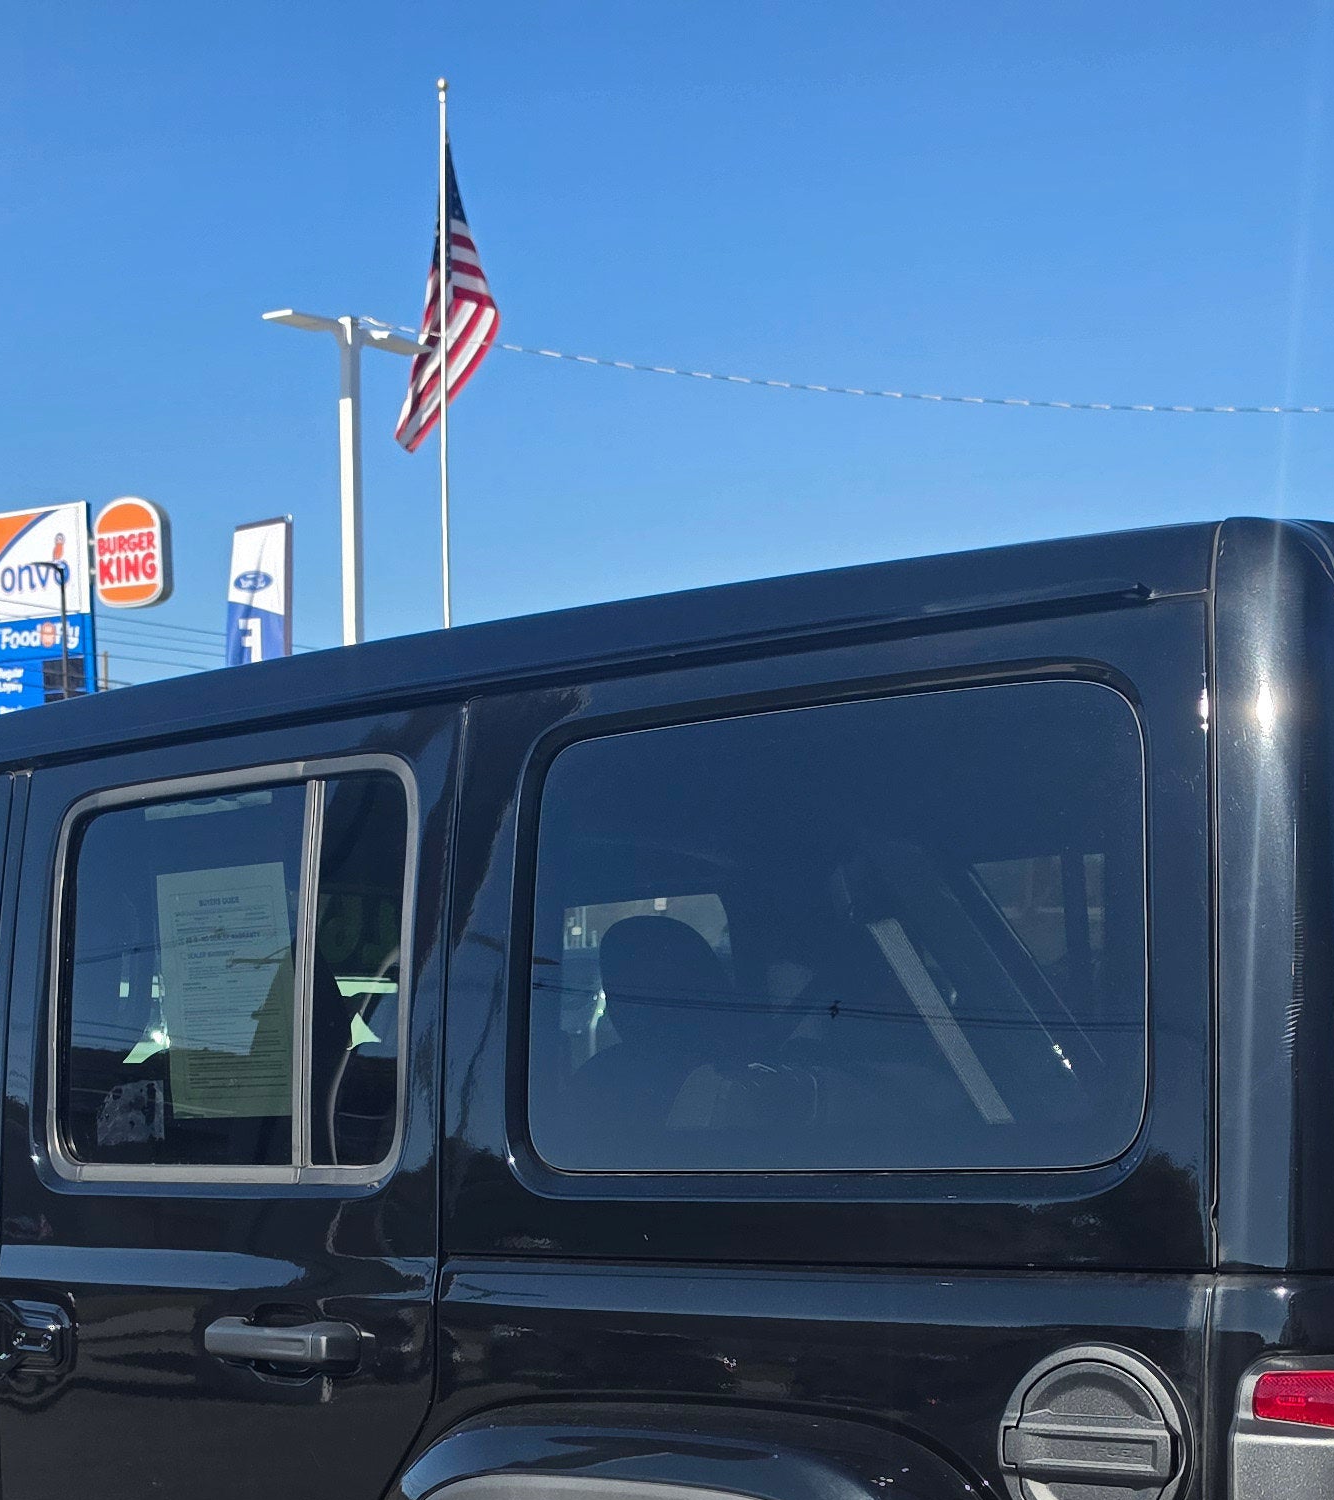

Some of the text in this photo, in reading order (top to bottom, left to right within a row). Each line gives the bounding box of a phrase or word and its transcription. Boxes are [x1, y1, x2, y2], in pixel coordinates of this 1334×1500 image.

[97, 531, 156, 557] BURGER
[0, 561, 70, 593] onvo
[99, 552, 157, 585] KING
[1098, 1445, 1144, 1460] FUEL
